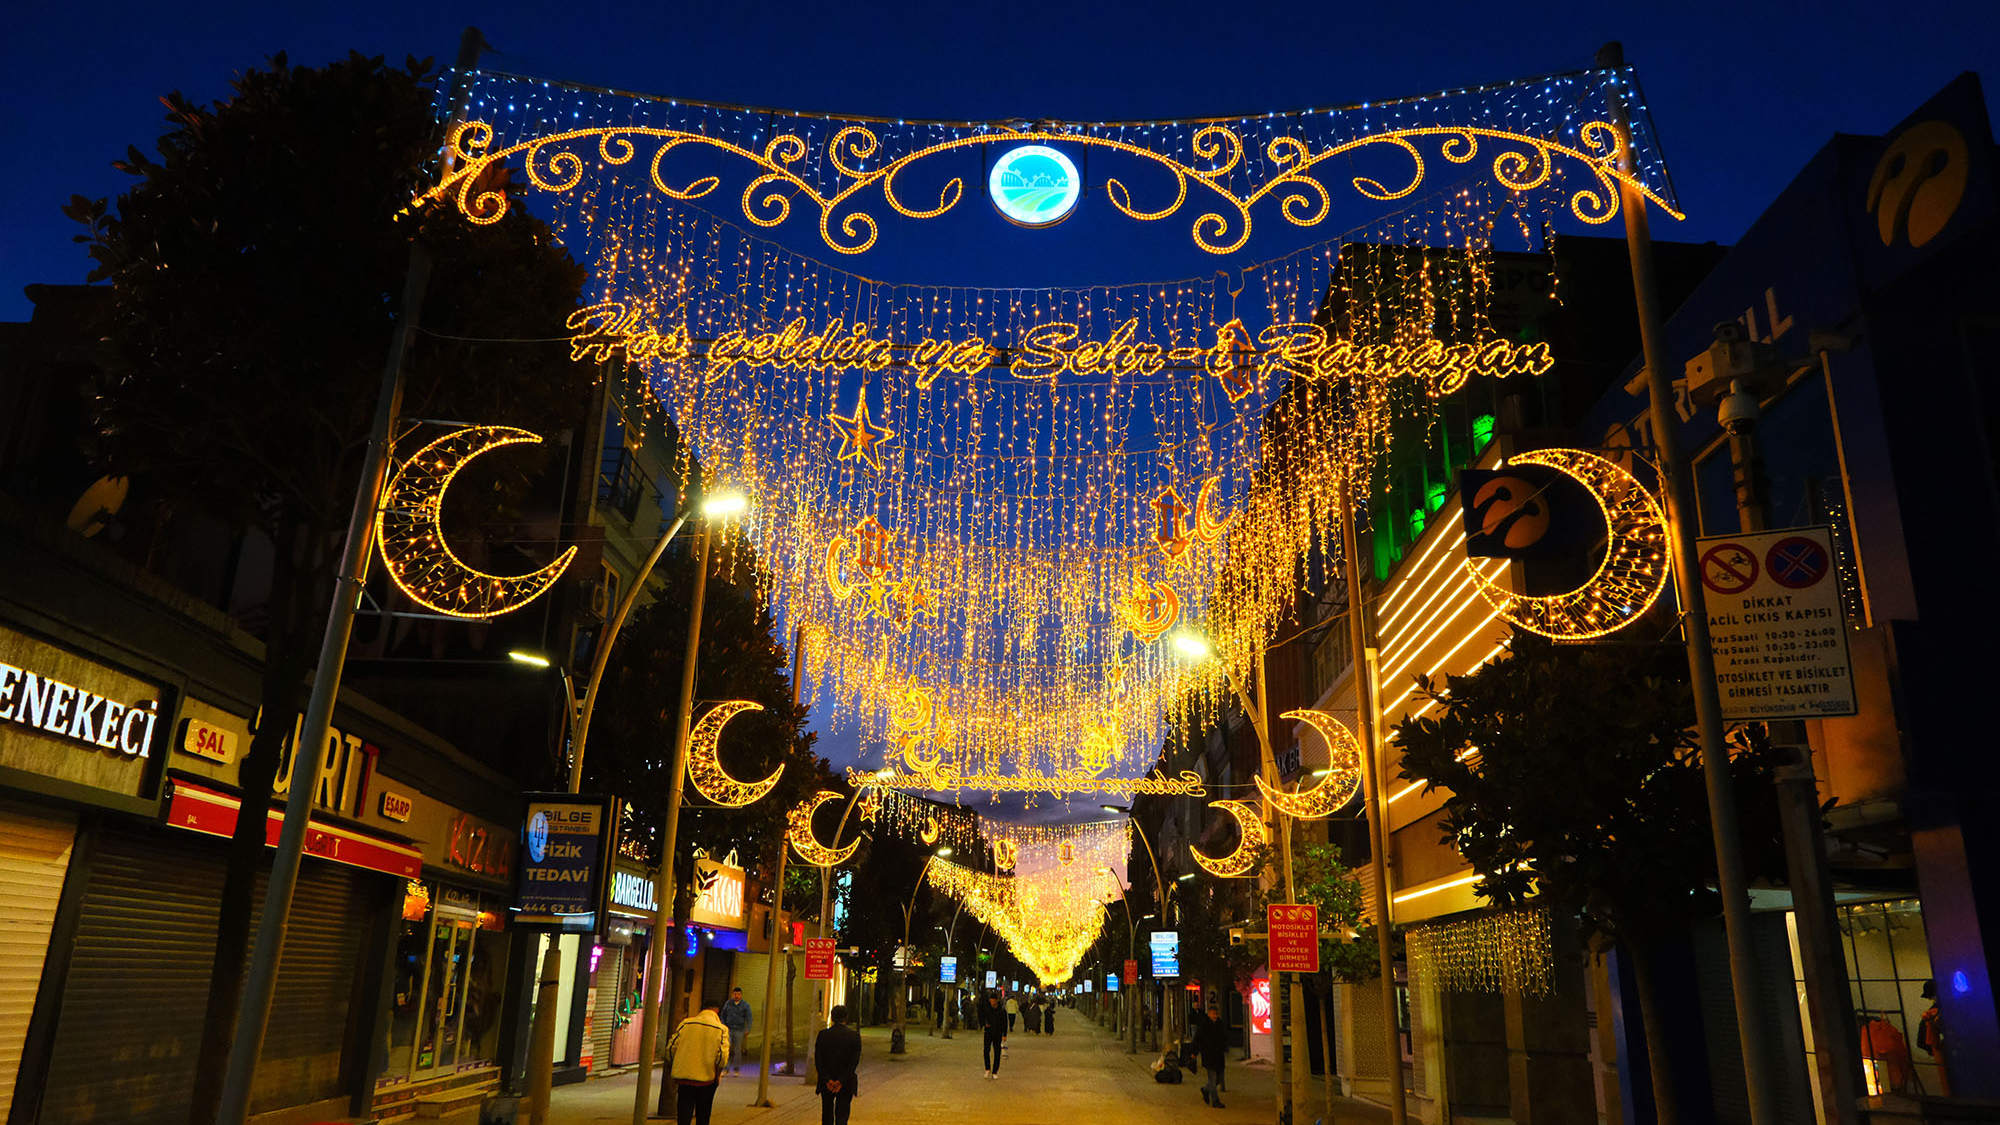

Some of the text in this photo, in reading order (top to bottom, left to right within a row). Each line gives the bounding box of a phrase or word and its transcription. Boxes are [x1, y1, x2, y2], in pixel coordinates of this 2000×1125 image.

[704, 316, 893, 384] geldin
[911, 337, 993, 389] ya
[1258, 323, 1555, 395] Ramazan
[1743, 596, 1792, 609] DİKKAT
[1710, 613, 1739, 626] ACİL
[1785, 608, 1832, 621] KAPISI
[1731, 633, 1759, 642] Saati
[1765, 630, 1795, 640] 10:30
[1804, 628, 1836, 637] 24:00
[1731, 645, 1759, 654] Saati
[1765, 642, 1796, 652] 10:30
[1730, 657, 1760, 666] Arası
[1718, 666, 1845, 684] OTOSİKLET VE BİSİKLET
[1728, 683, 1830, 698] GİRMESİ YASAKTIR
[197, 727, 225, 755] ŞAL
[385, 796, 410, 816] EŞARP
[541, 841, 583, 858] FİZİK
[526, 866, 590, 883] TEDAVİ
[614, 871, 654, 911] BARGELLO
[523, 903, 547, 913] 444
[550, 903, 563, 913] 62
[1271, 923, 1314, 931] MOTOSİKLET
